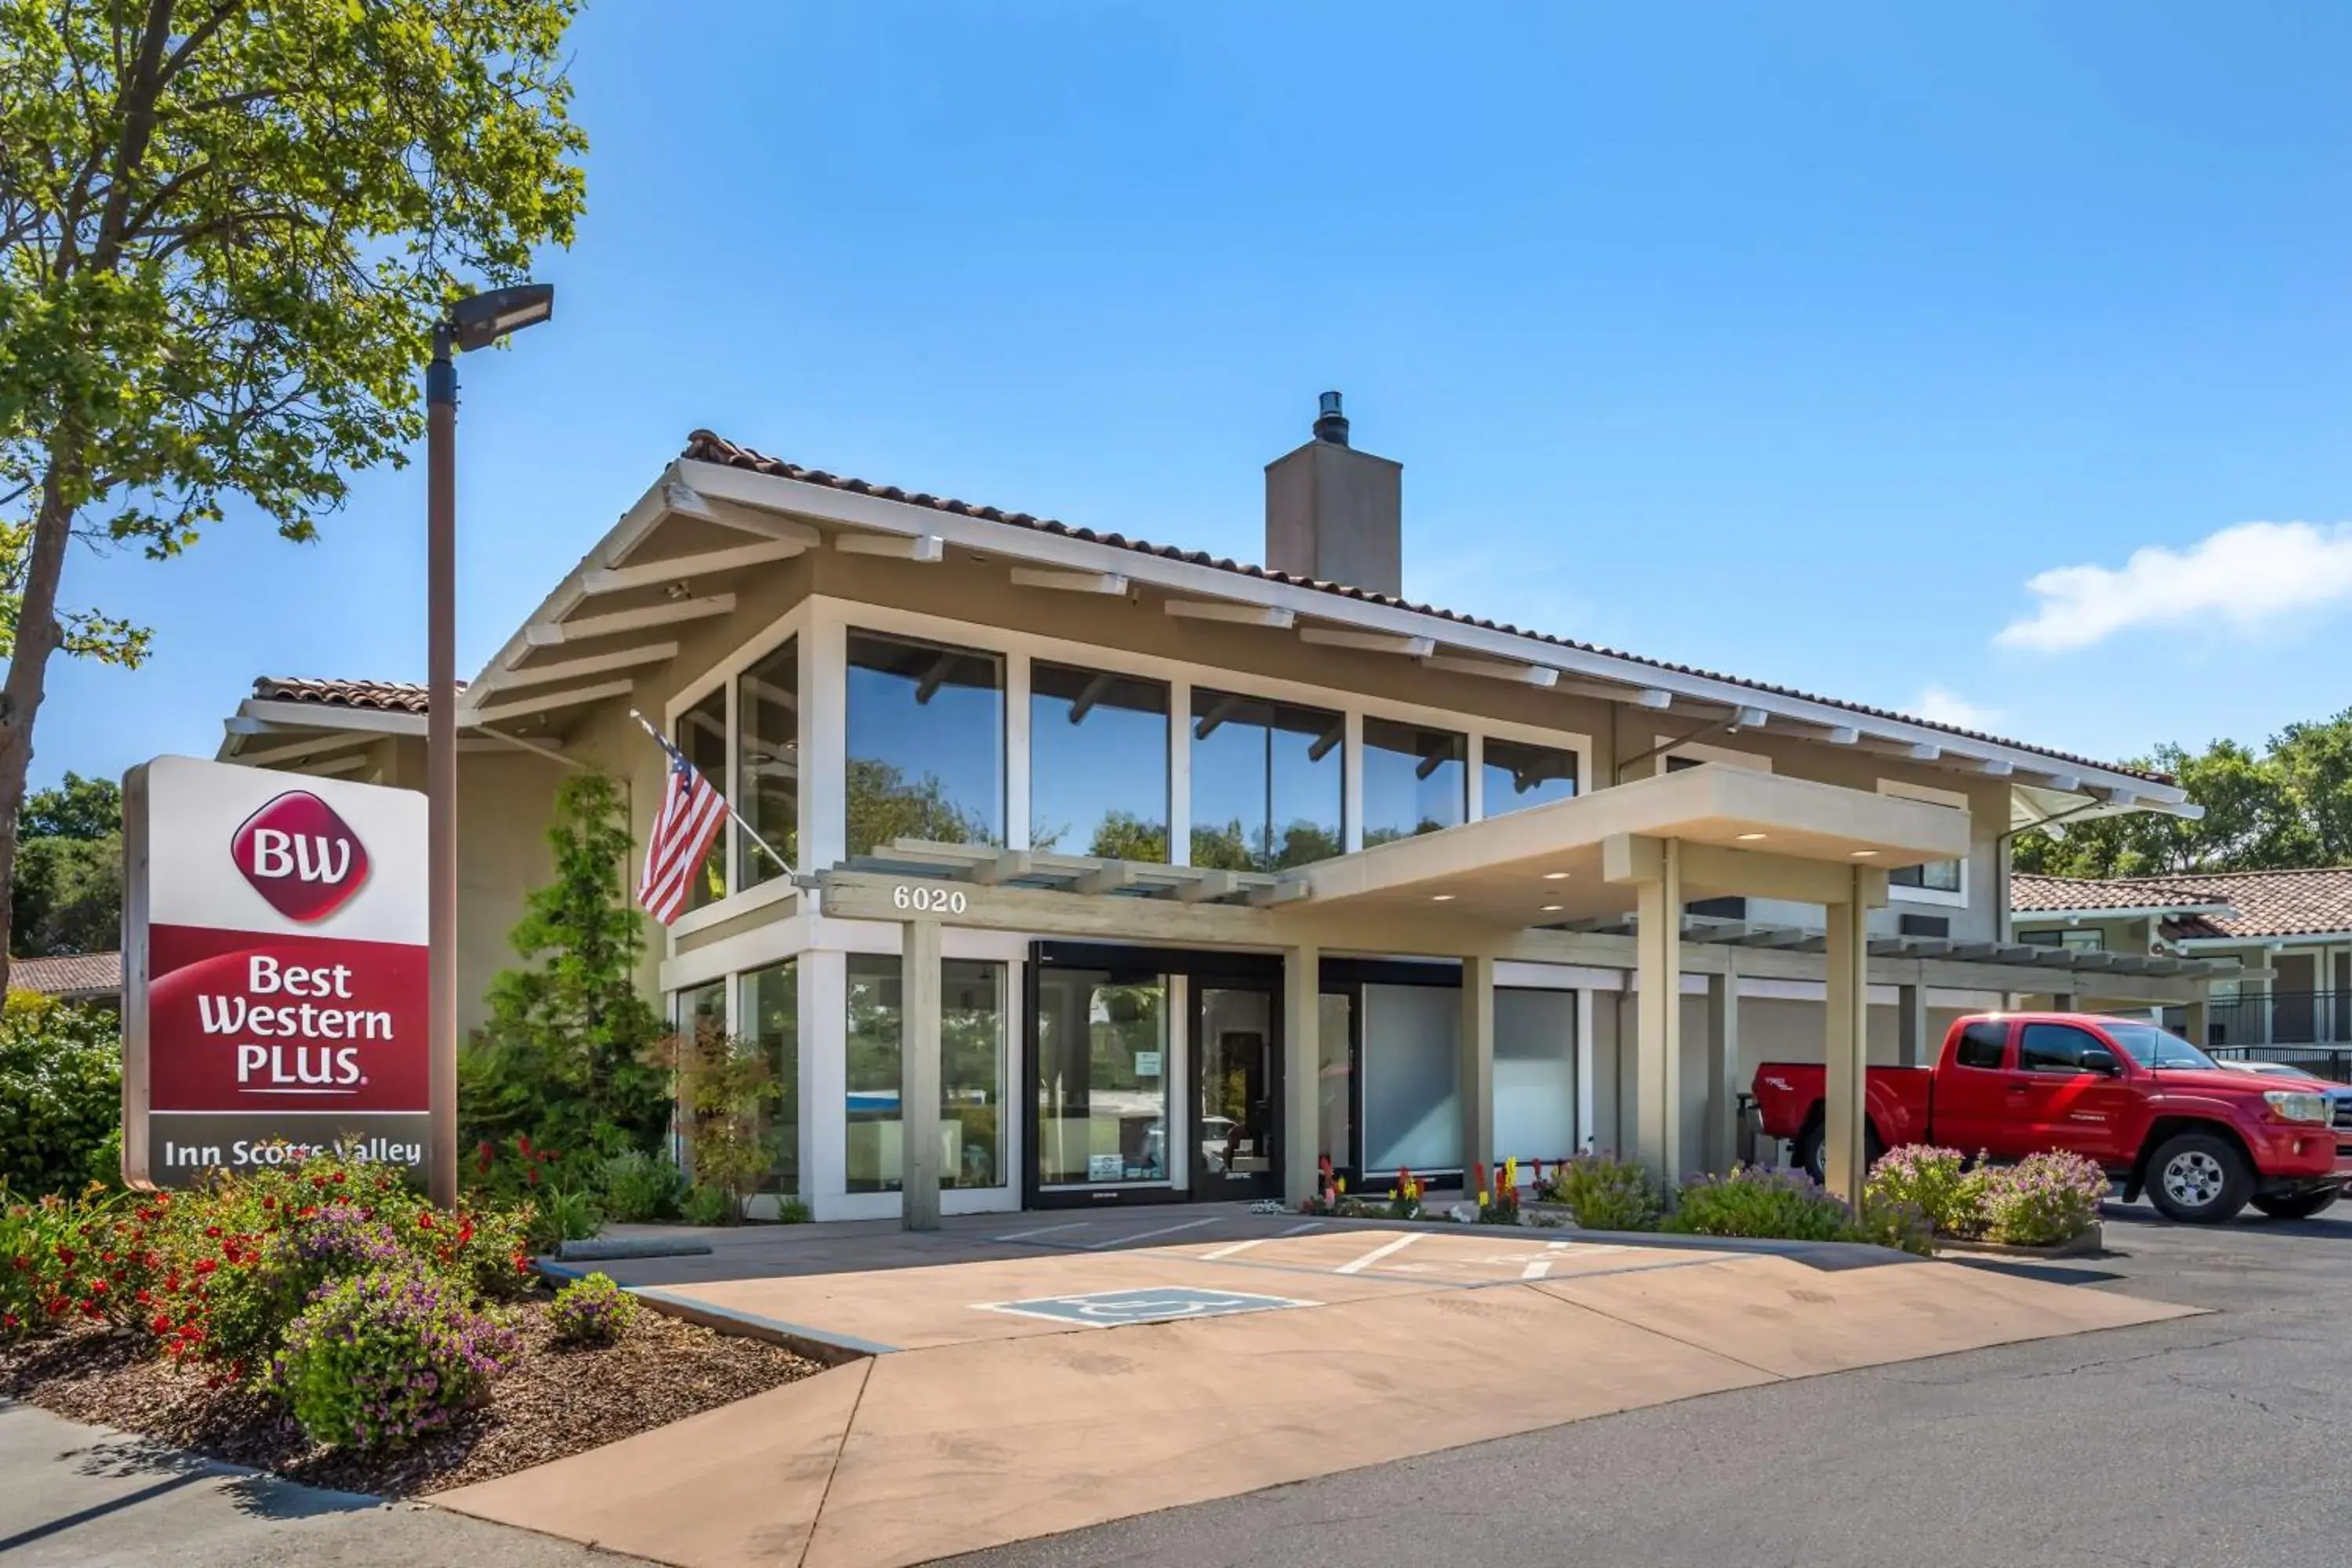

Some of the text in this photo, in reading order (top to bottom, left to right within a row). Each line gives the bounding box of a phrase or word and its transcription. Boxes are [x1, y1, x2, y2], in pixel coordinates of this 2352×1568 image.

[254, 829, 350, 884] BW
[894, 885, 967, 914] 6020
[249, 955, 353, 999] Best
[198, 994, 394, 1040] Western
[165, 1141, 221, 1166] Inn
